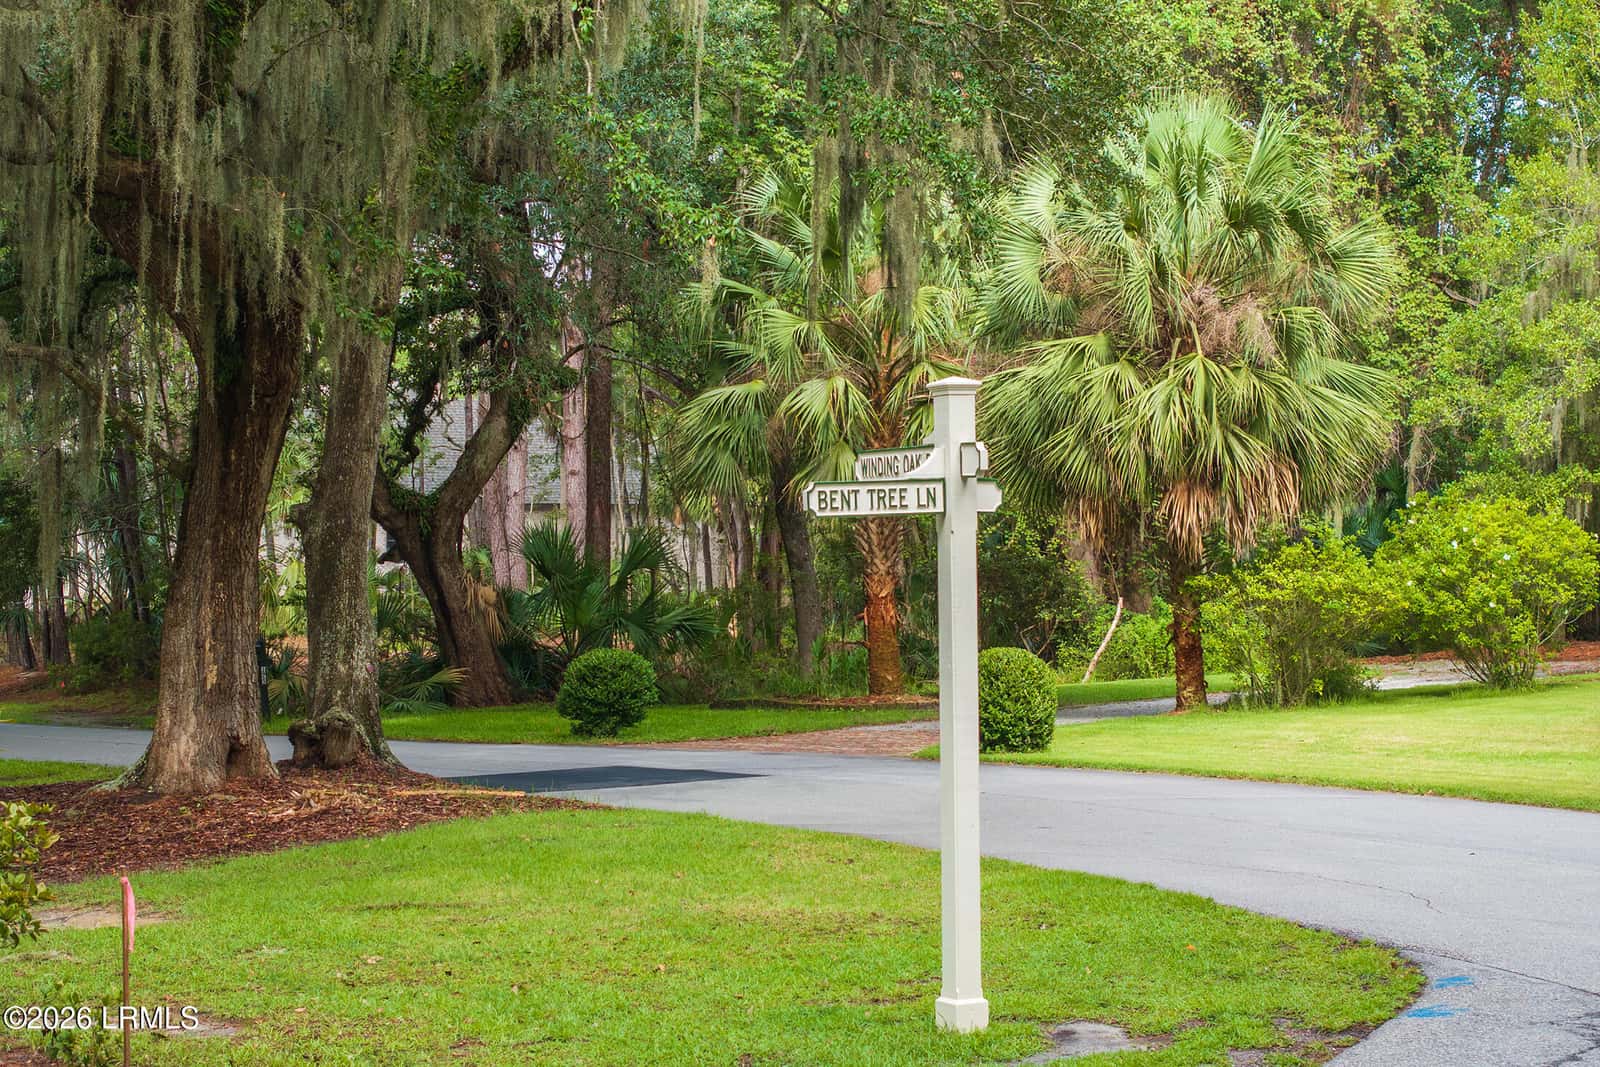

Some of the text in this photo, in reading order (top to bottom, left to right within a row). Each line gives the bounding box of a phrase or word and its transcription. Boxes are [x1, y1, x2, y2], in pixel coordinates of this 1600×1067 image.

[861, 455, 900, 479] WINDING
[817, 487, 937, 511] BENT TREE LN
